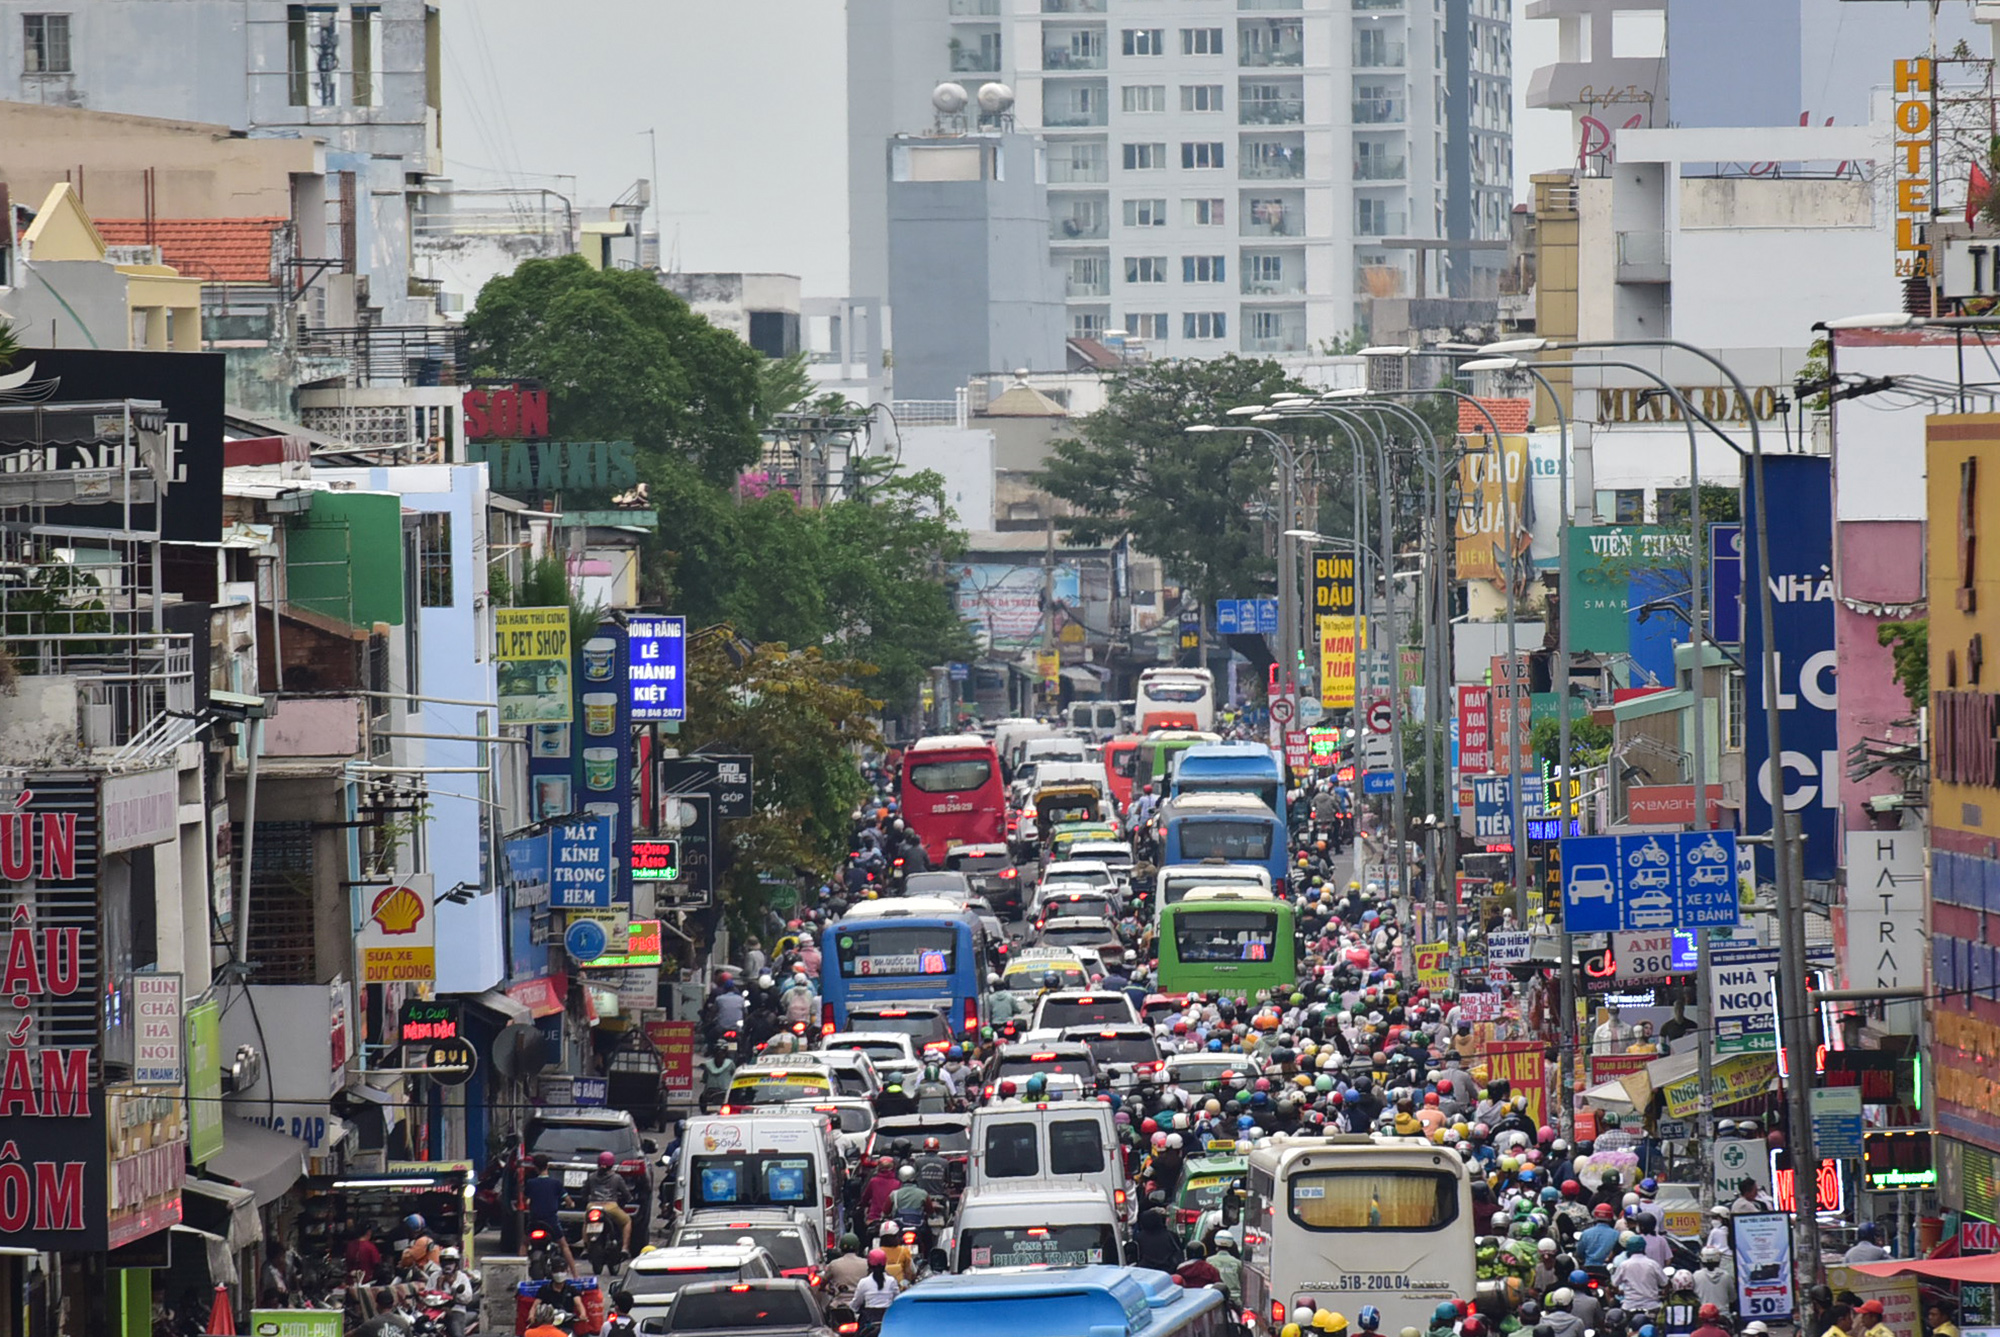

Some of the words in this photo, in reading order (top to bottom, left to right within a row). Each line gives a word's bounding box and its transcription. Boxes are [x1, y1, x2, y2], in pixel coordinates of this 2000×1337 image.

[1894, 59, 1931, 251] HOTEL
[1315, 555, 1353, 579] BÚN
[1316, 581, 1353, 611] ĐẬU
[512, 632, 533, 656] PET
[537, 631, 567, 656] SHOP
[641, 641, 659, 659] LÊ
[634, 684, 667, 704] KIỆT
[1464, 690, 1487, 708] MÁY
[1466, 712, 1486, 726] XOA
[1465, 732, 1486, 746] BÓP
[564, 822, 597, 841] MẮT
[561, 844, 600, 862] KÍNH
[554, 868, 605, 881] TRONG
[1686, 894, 1702, 906] XE
[1702, 895, 1712, 904] 2
[1715, 889, 1733, 904] VÀ
[1686, 911, 1694, 922] 3
[1697, 906, 1734, 921] BÁNH
[397, 951, 413, 961] XE
[367, 965, 389, 980] DUY
[1719, 968, 1757, 986] NHÀ
[140, 977, 177, 994] BÚN
[1491, 1044, 1510, 1080] XẢ
[1515, 1044, 1540, 1080] HẾT
[1043, 1240, 1058, 1250] TY
[1340, 1275, 1410, 1290] 51B-200.04
[1750, 1298, 1776, 1314] 50
